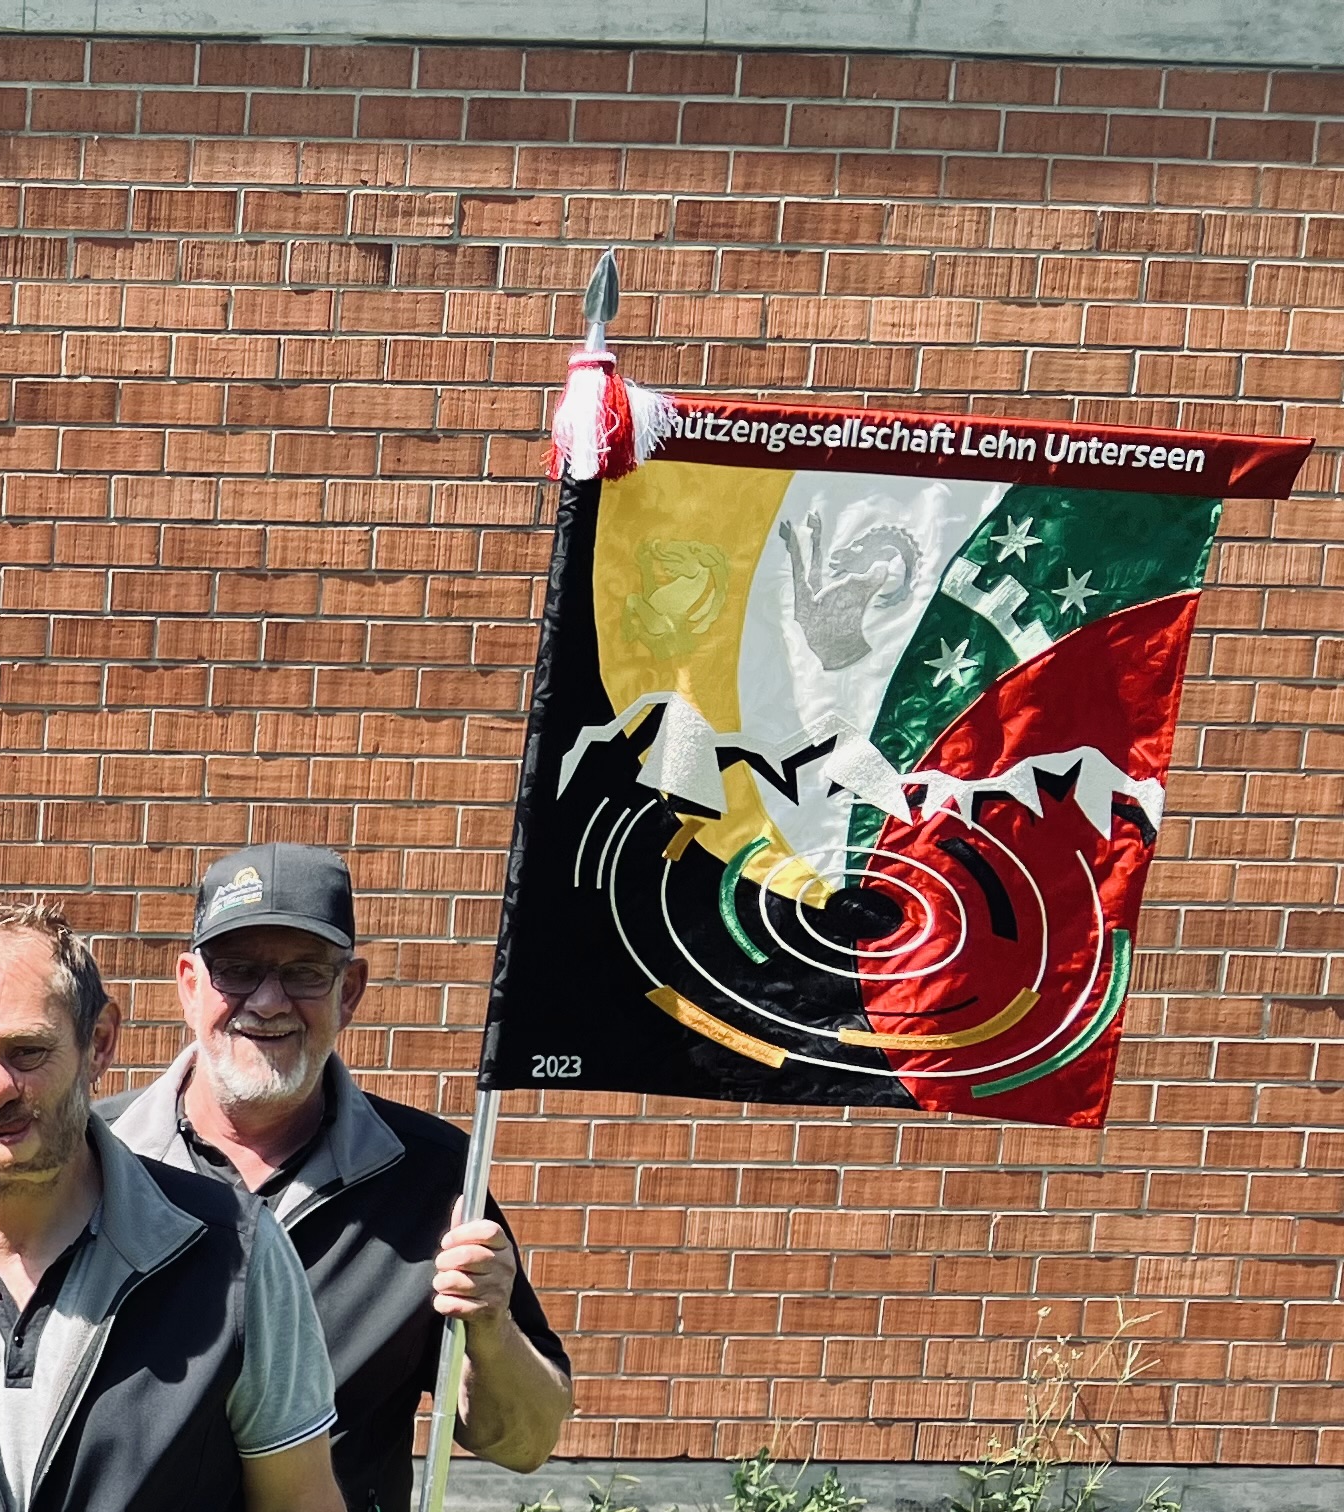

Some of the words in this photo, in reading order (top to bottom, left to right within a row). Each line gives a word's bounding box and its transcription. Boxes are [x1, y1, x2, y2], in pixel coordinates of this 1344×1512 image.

[665, 411, 956, 455] hützengesellschaft
[960, 426, 1037, 461] Lehn
[1044, 433, 1206, 473] Unterseen
[531, 1054, 582, 1078] 2023
